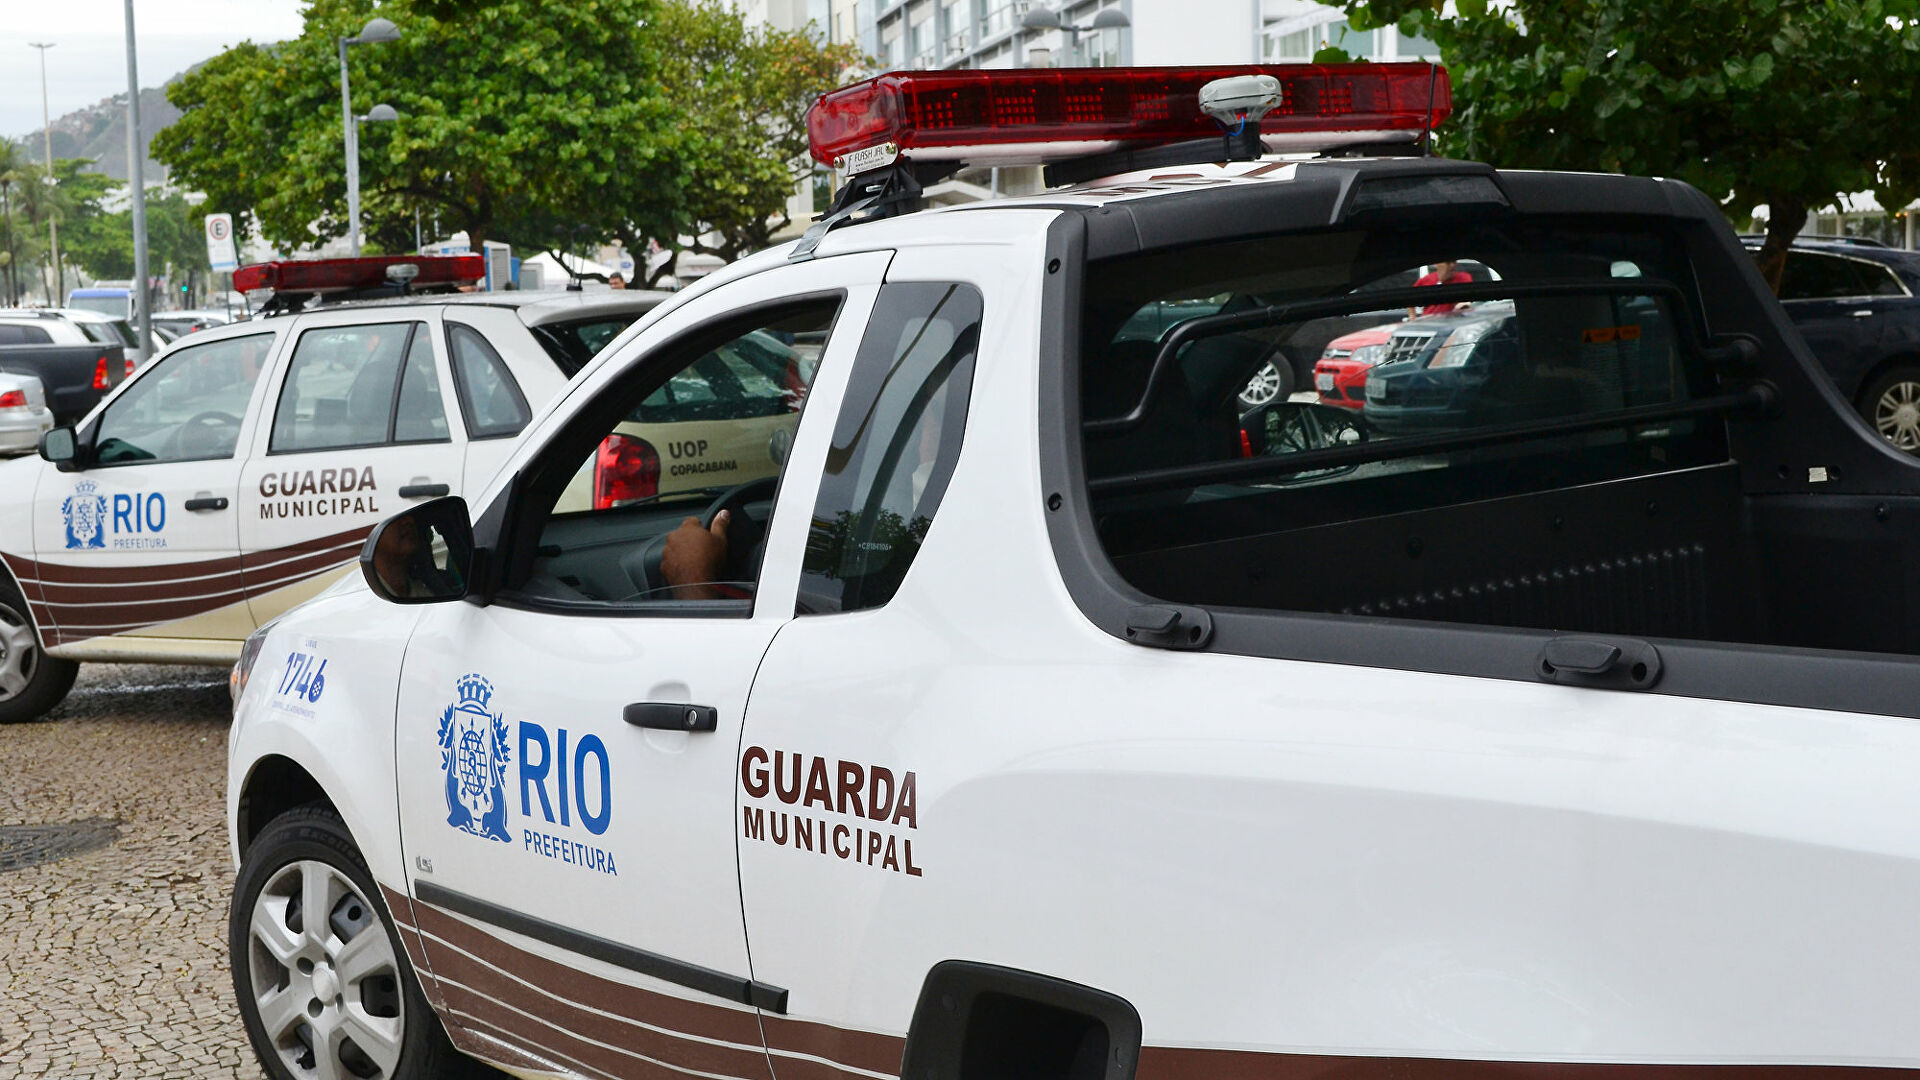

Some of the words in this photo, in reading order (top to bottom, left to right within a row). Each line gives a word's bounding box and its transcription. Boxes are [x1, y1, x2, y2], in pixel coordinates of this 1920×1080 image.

[215, 223, 223, 235] E
[668, 440, 708, 459] UOP
[259, 466, 377, 497] GUARDA
[670, 460, 738, 477] COPACABANA
[113, 492, 166, 533] RIO
[260, 496, 379, 519] MUNICIPAL
[114, 538, 168, 549] PREFEITURA
[278, 651, 328, 703] 1746
[519, 720, 612, 836] RIO
[741, 746, 917, 829] GUARDA
[524, 829, 618, 876] PREFEITURA
[743, 805, 923, 877] MUNICIPAL
